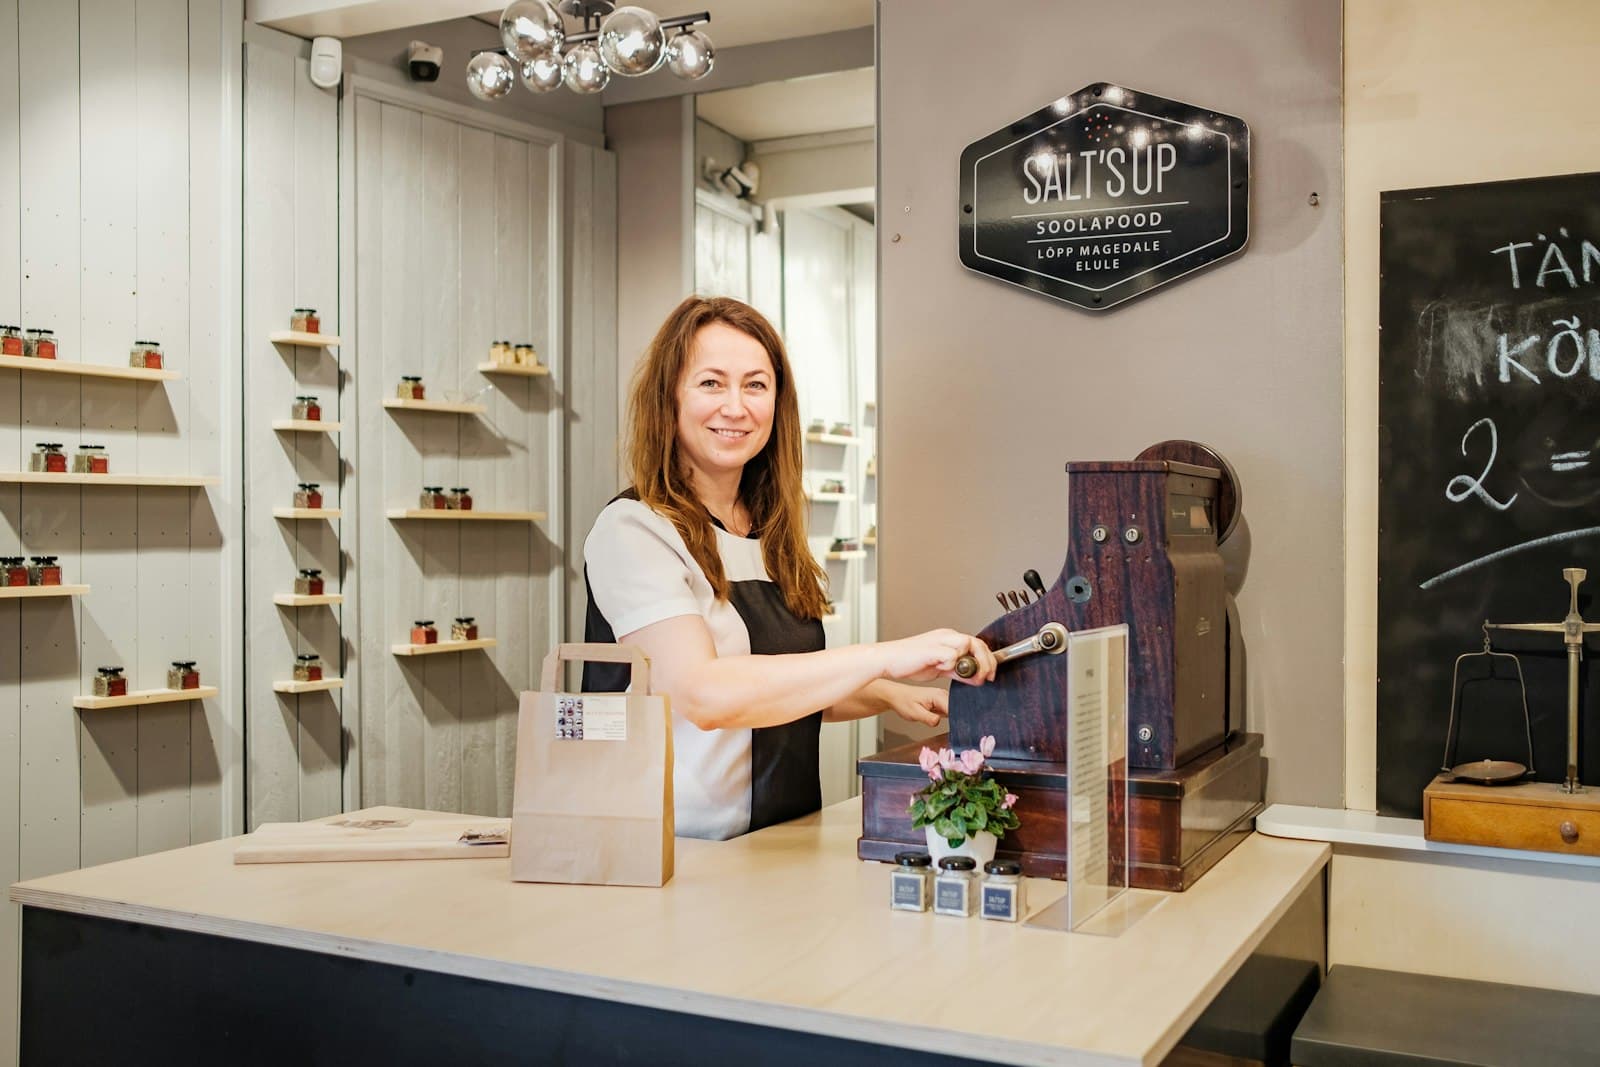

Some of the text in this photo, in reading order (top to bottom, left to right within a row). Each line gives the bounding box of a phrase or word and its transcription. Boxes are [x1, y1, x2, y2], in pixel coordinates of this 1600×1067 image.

[1023, 143, 1177, 205] SALT'S UP
[1036, 211, 1163, 235] SOOLAPOOD
[1037, 240, 1161, 260] LÕPP MAGEDALE
[1076, 258, 1120, 272] ELULE
[1445, 416, 1518, 511] 2
